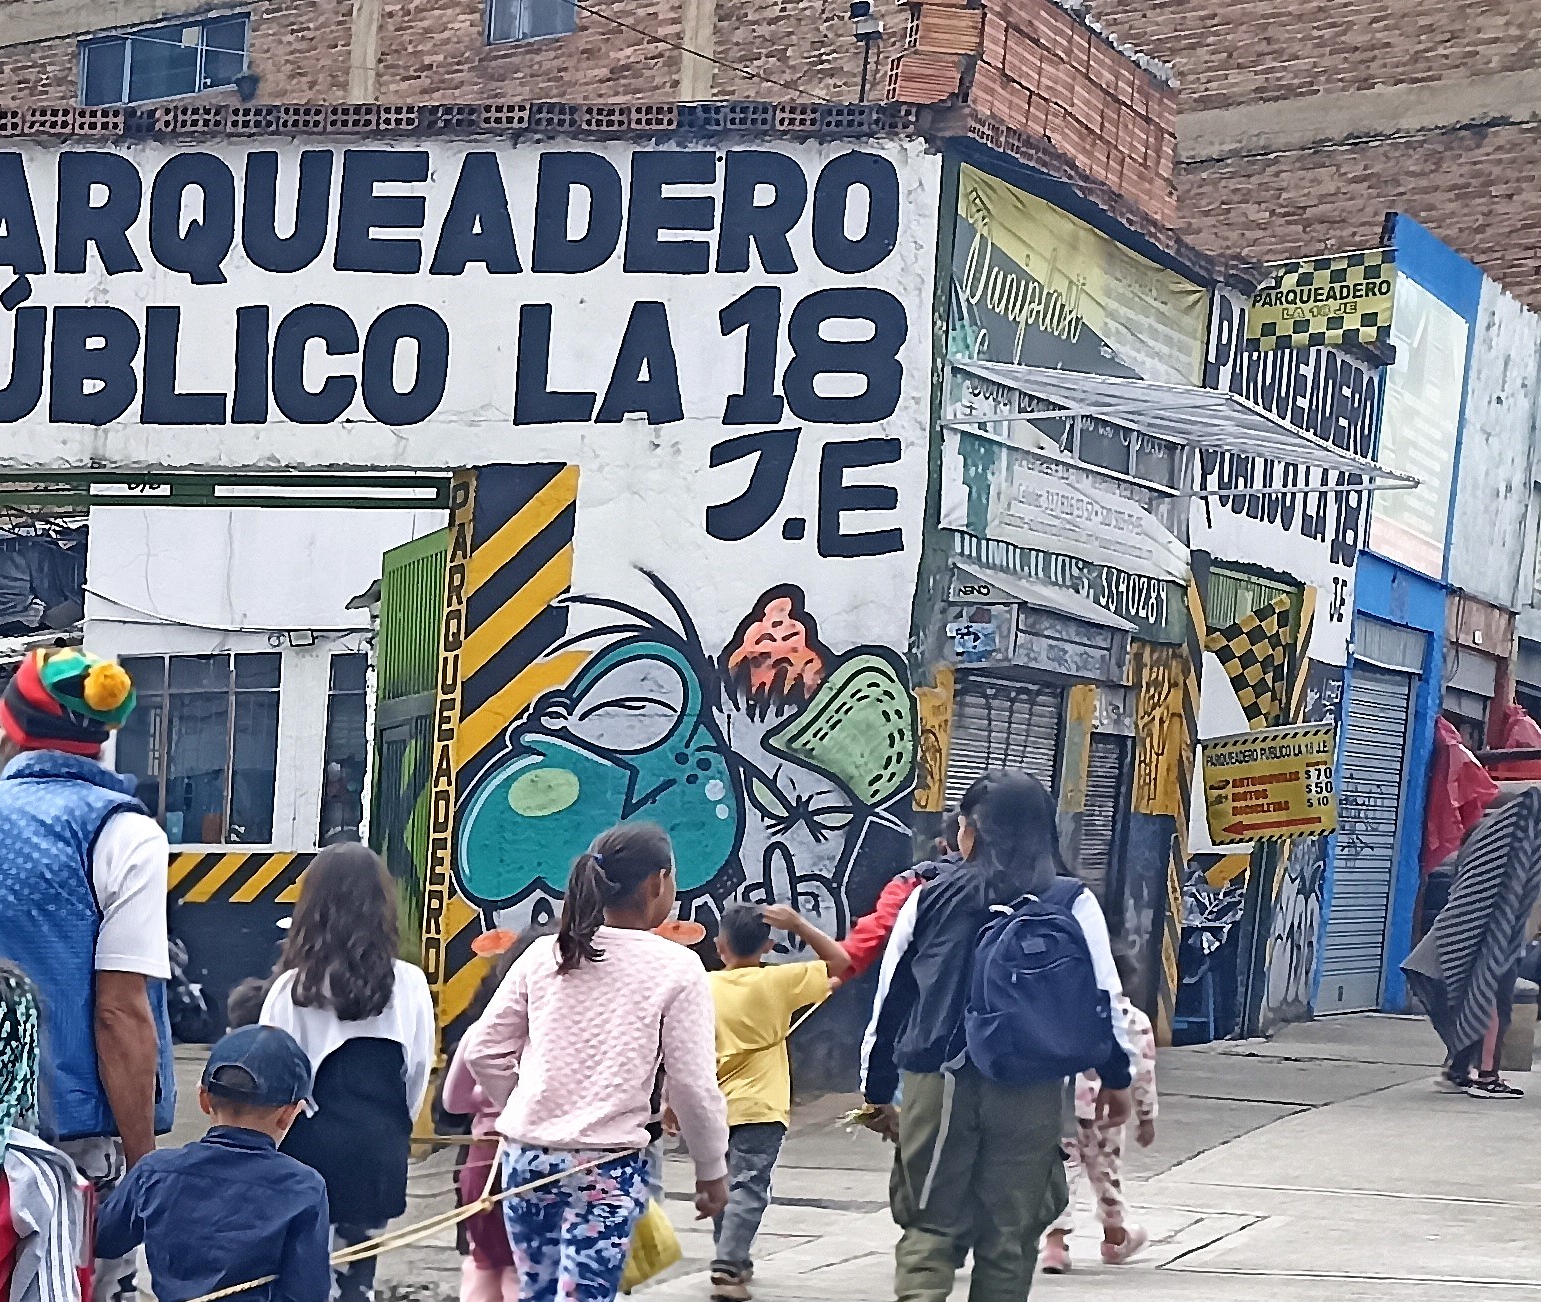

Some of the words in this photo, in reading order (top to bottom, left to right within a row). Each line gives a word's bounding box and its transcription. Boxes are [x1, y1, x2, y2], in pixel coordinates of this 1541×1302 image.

[1251, 279, 1392, 308] PARQUEADERO
[1281, 306, 1306, 320] LA
[1333, 301, 1358, 315] JE
[513, 301, 684, 425] LA
[717, 285, 909, 425] 18
[424, 482, 470, 986] PARQUEADERO
